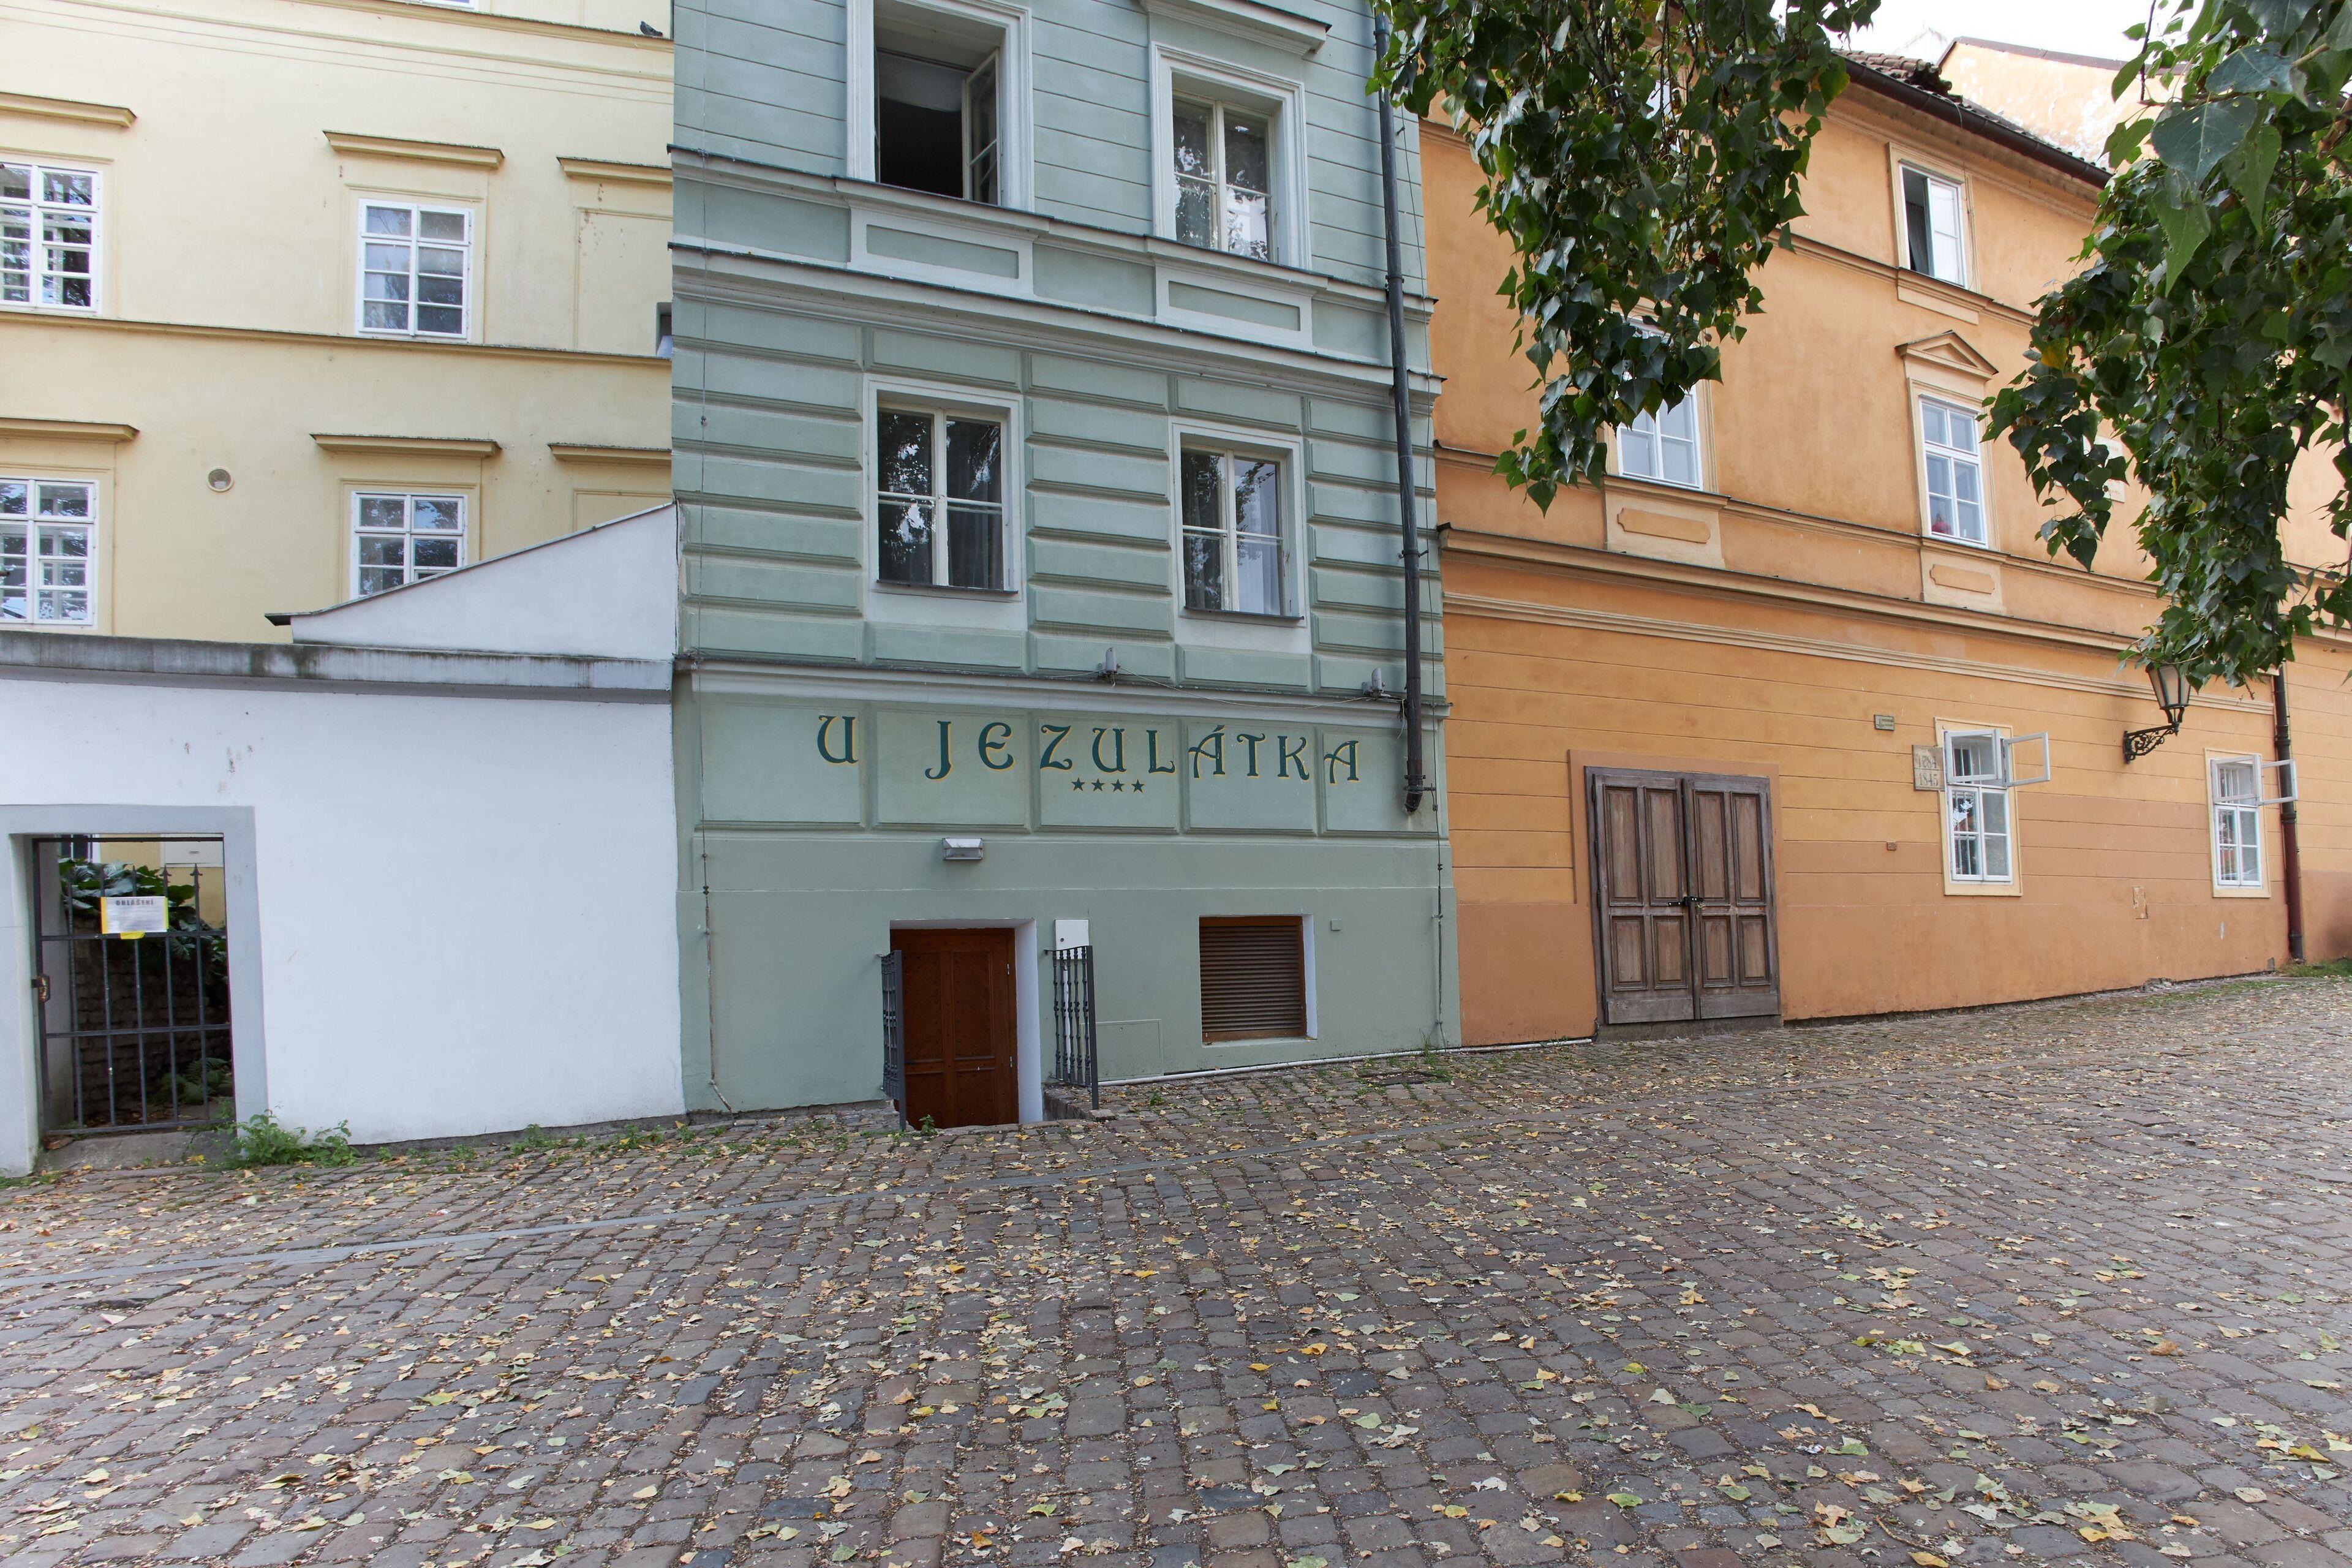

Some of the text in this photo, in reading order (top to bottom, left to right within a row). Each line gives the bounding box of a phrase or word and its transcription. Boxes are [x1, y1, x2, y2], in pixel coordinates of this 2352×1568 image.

[817, 715, 1360, 785] U JEZULÁTKA
[1919, 773, 1939, 786] 1845
